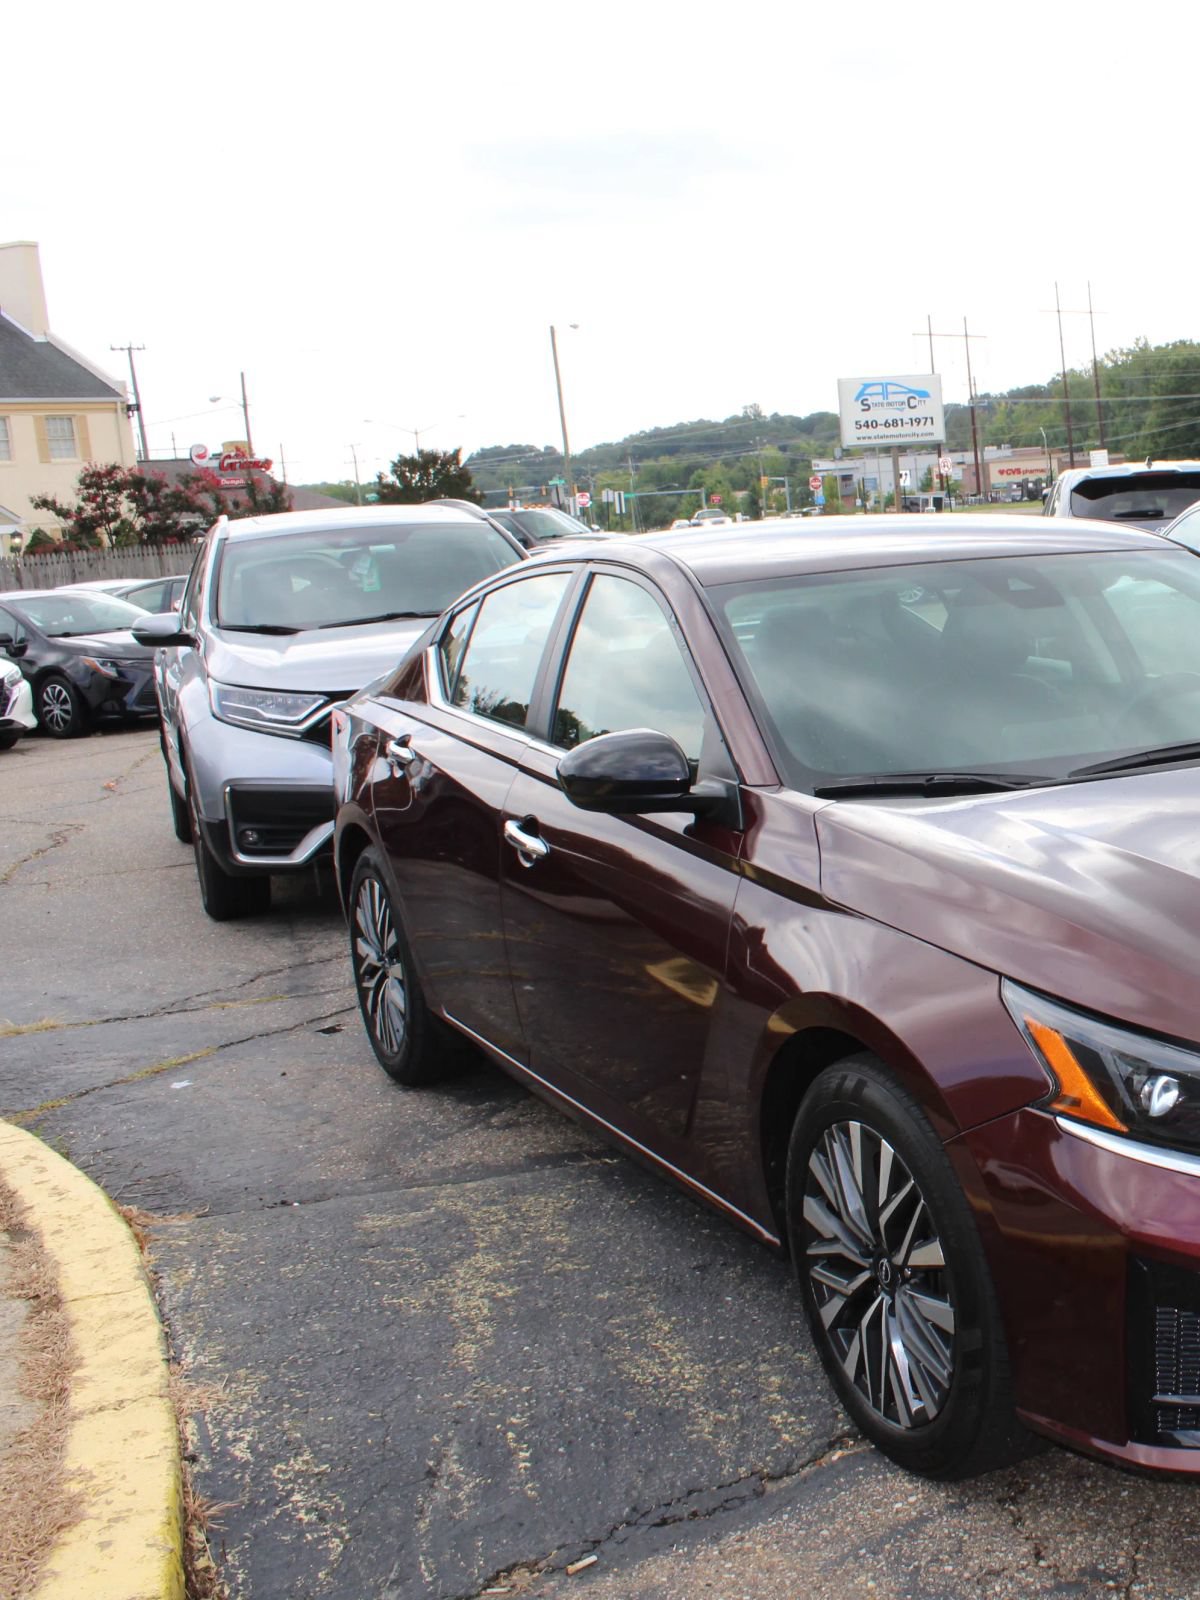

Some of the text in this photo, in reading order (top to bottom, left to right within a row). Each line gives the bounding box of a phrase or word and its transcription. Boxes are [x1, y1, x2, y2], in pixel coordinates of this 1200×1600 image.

[860, 395, 927, 412] STATE MOTOR CITY
[854, 416, 935, 431] 540-681-1971
[855, 431, 935, 441] www.statemotorcity.com
[1006, 467, 1022, 476] CVS
